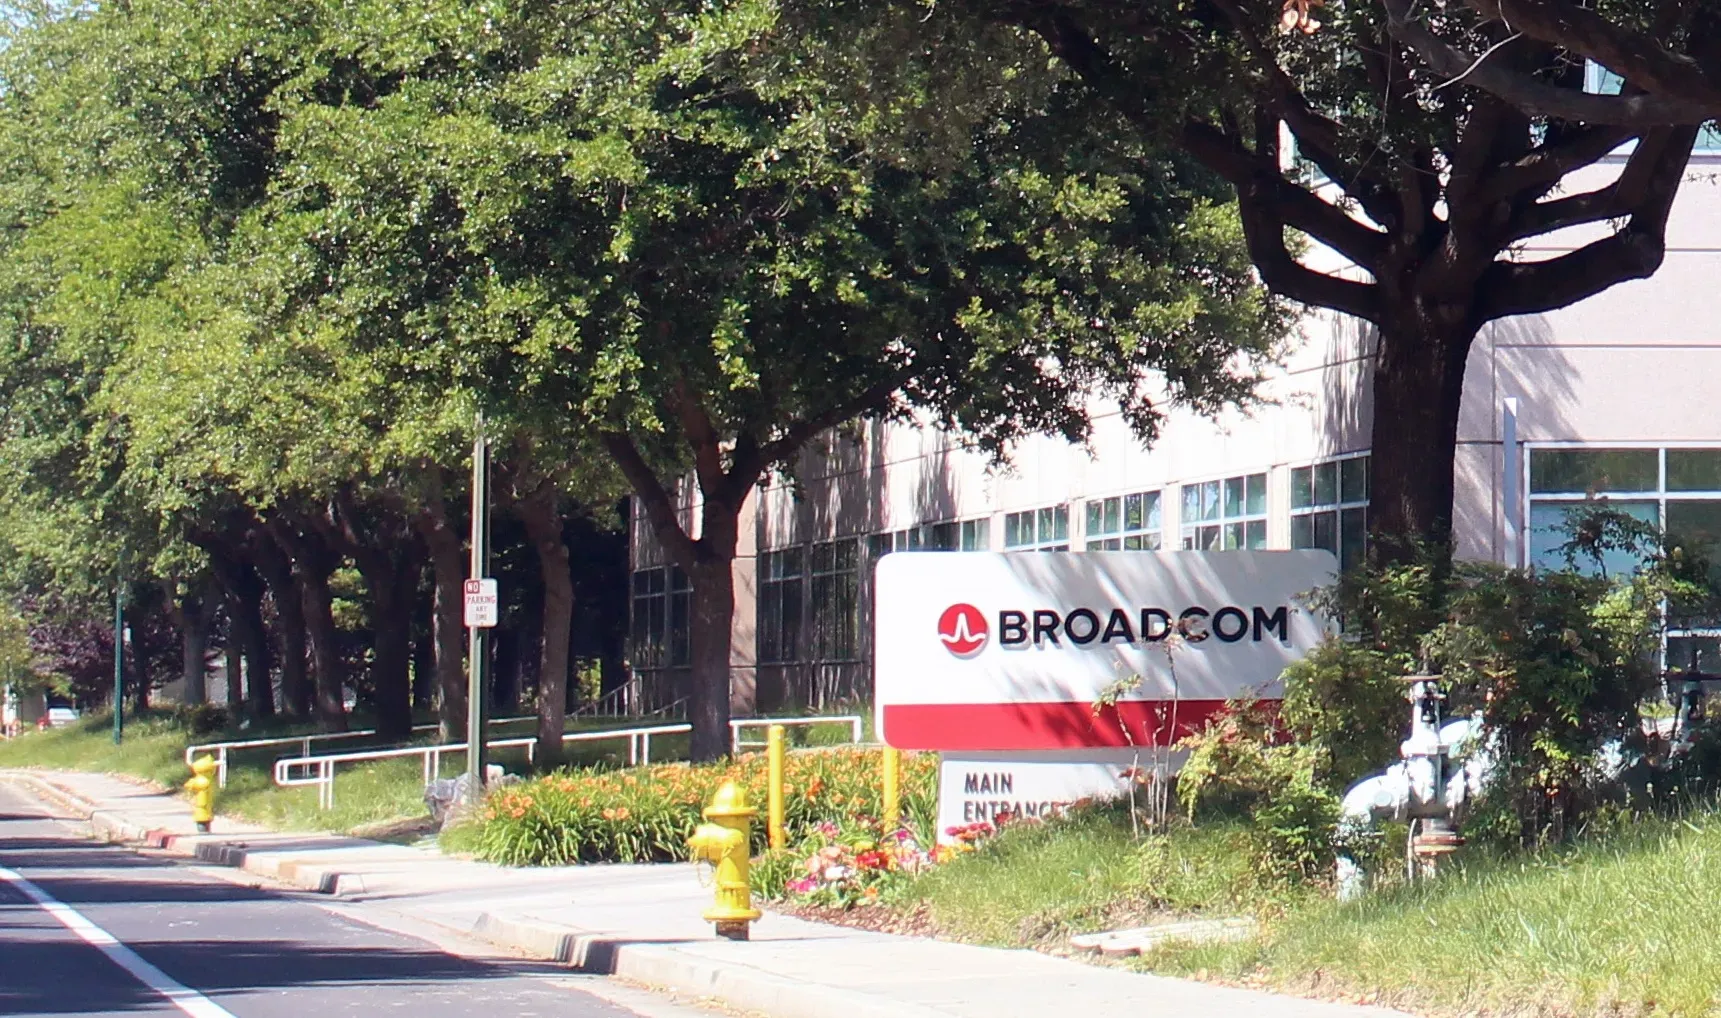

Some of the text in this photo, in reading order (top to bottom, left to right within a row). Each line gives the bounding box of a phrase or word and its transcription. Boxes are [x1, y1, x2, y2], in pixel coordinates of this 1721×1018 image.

[467, 581, 479, 593] NO
[466, 595, 496, 604] PARKING
[1000, 606, 1287, 644] BROADCOM
[964, 772, 1013, 794] MAIN
